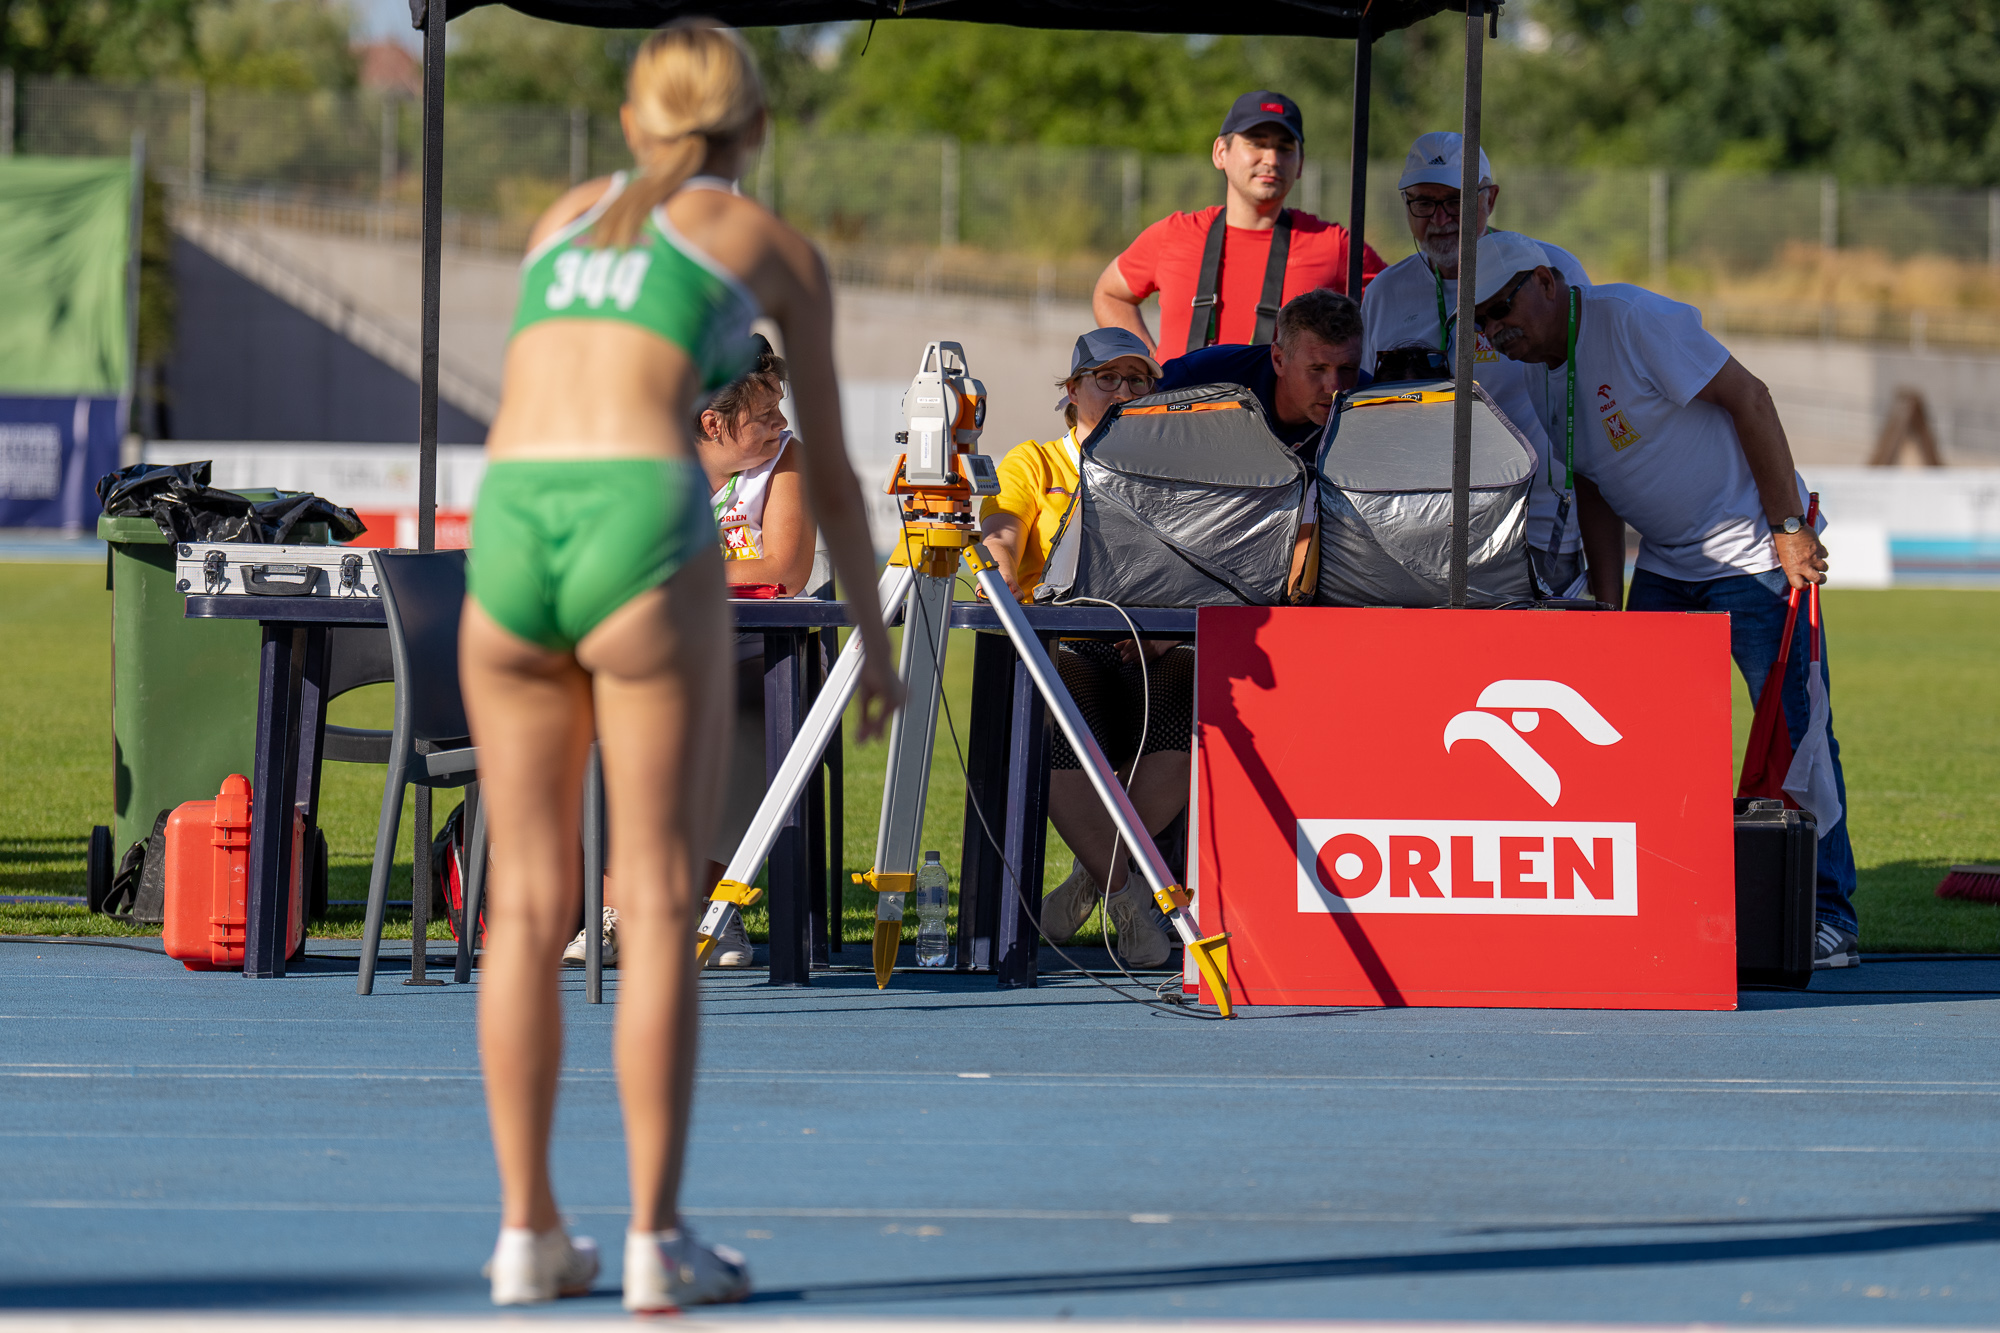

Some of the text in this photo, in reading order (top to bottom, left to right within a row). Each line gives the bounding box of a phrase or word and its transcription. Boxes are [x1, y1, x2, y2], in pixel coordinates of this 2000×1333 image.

[545, 250, 651, 311] 344
[1600, 399, 1617, 412] ORLEN
[1316, 833, 1614, 900] ORLEN
